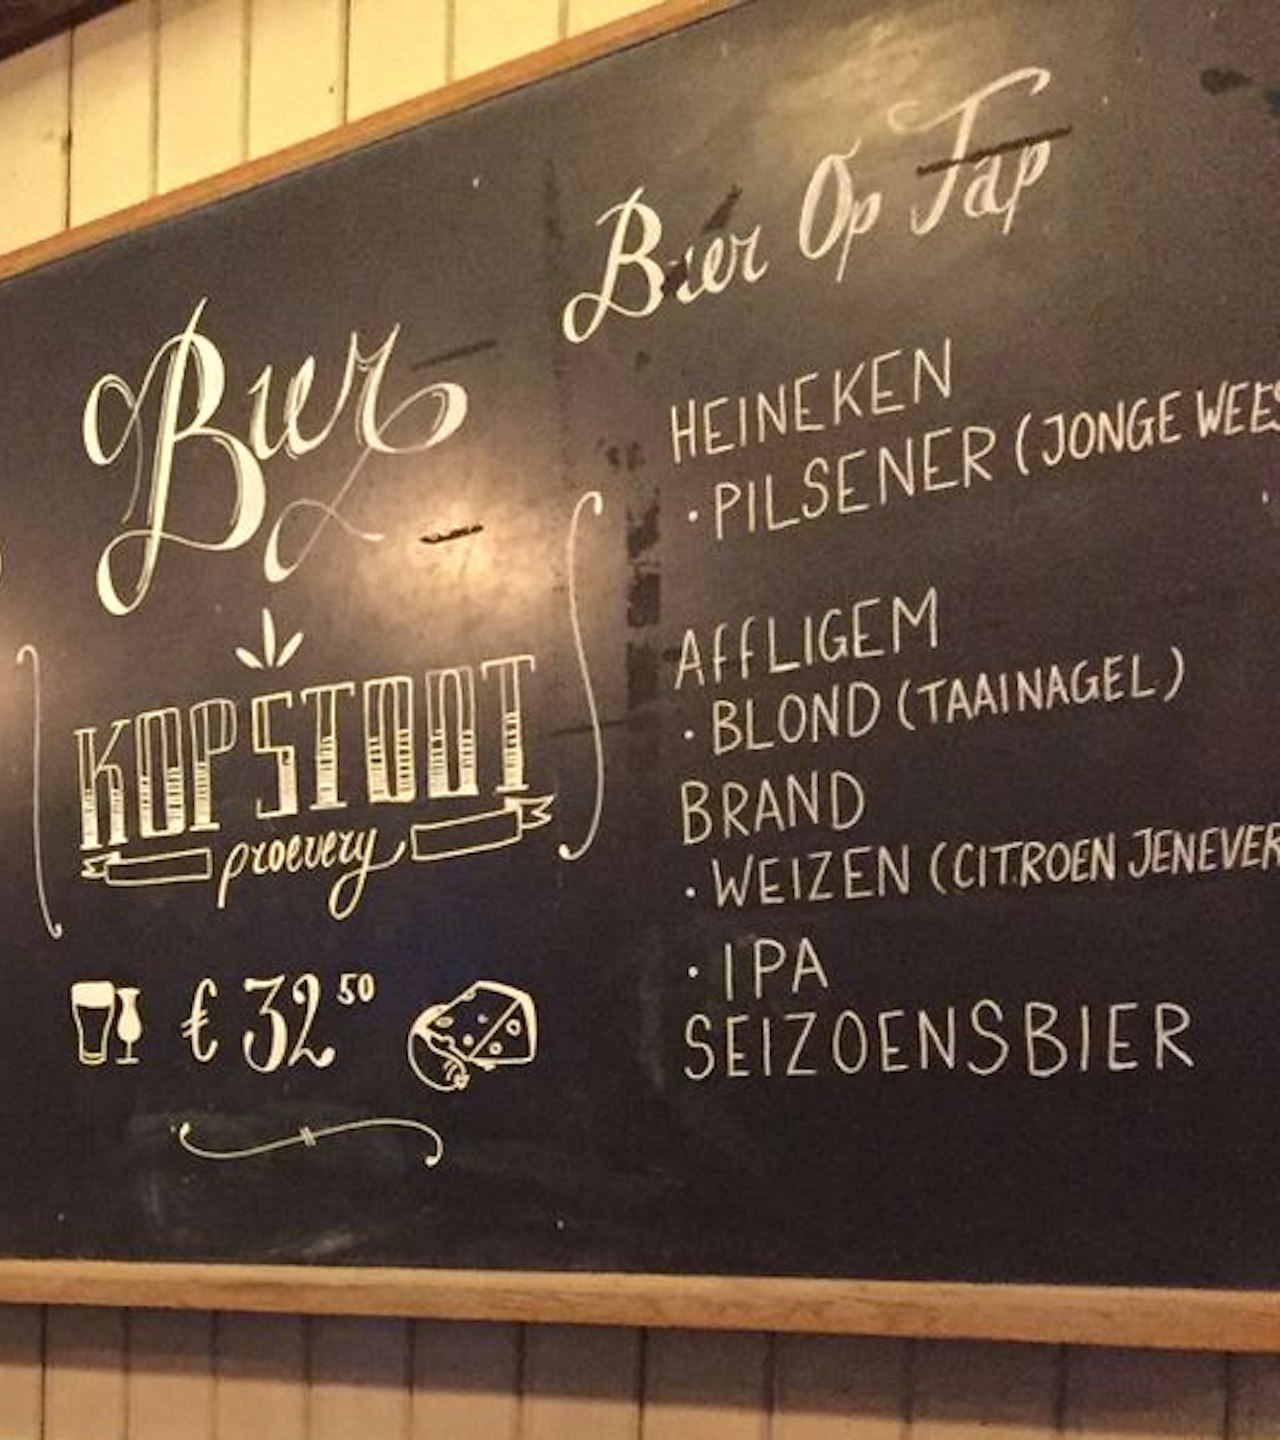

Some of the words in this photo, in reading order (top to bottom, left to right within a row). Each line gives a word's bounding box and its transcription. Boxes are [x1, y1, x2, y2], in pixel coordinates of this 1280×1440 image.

[562, 185, 769, 343] Bier
[798, 138, 882, 283] Op
[887, 66, 1052, 235] Tap
[670, 337, 952, 465] HEINEKEN
[714, 425, 996, 540] PILSENER
[1016, 390, 1182, 477] (JONGE
[72, 654, 535, 850] KOPSTOOT
[711, 679, 880, 756] BLOND
[896, 645, 1185, 732] (TAAINAGEL)
[679, 770, 864, 846] BRAND
[711, 843, 911, 909] WEIZEN
[929, 831, 1118, 896] (CITROEN
[1128, 821, 1280, 879] JENEVER
[724, 936, 829, 1002] IPA
[683, 998, 1195, 1081] SEIZOENSBIER
